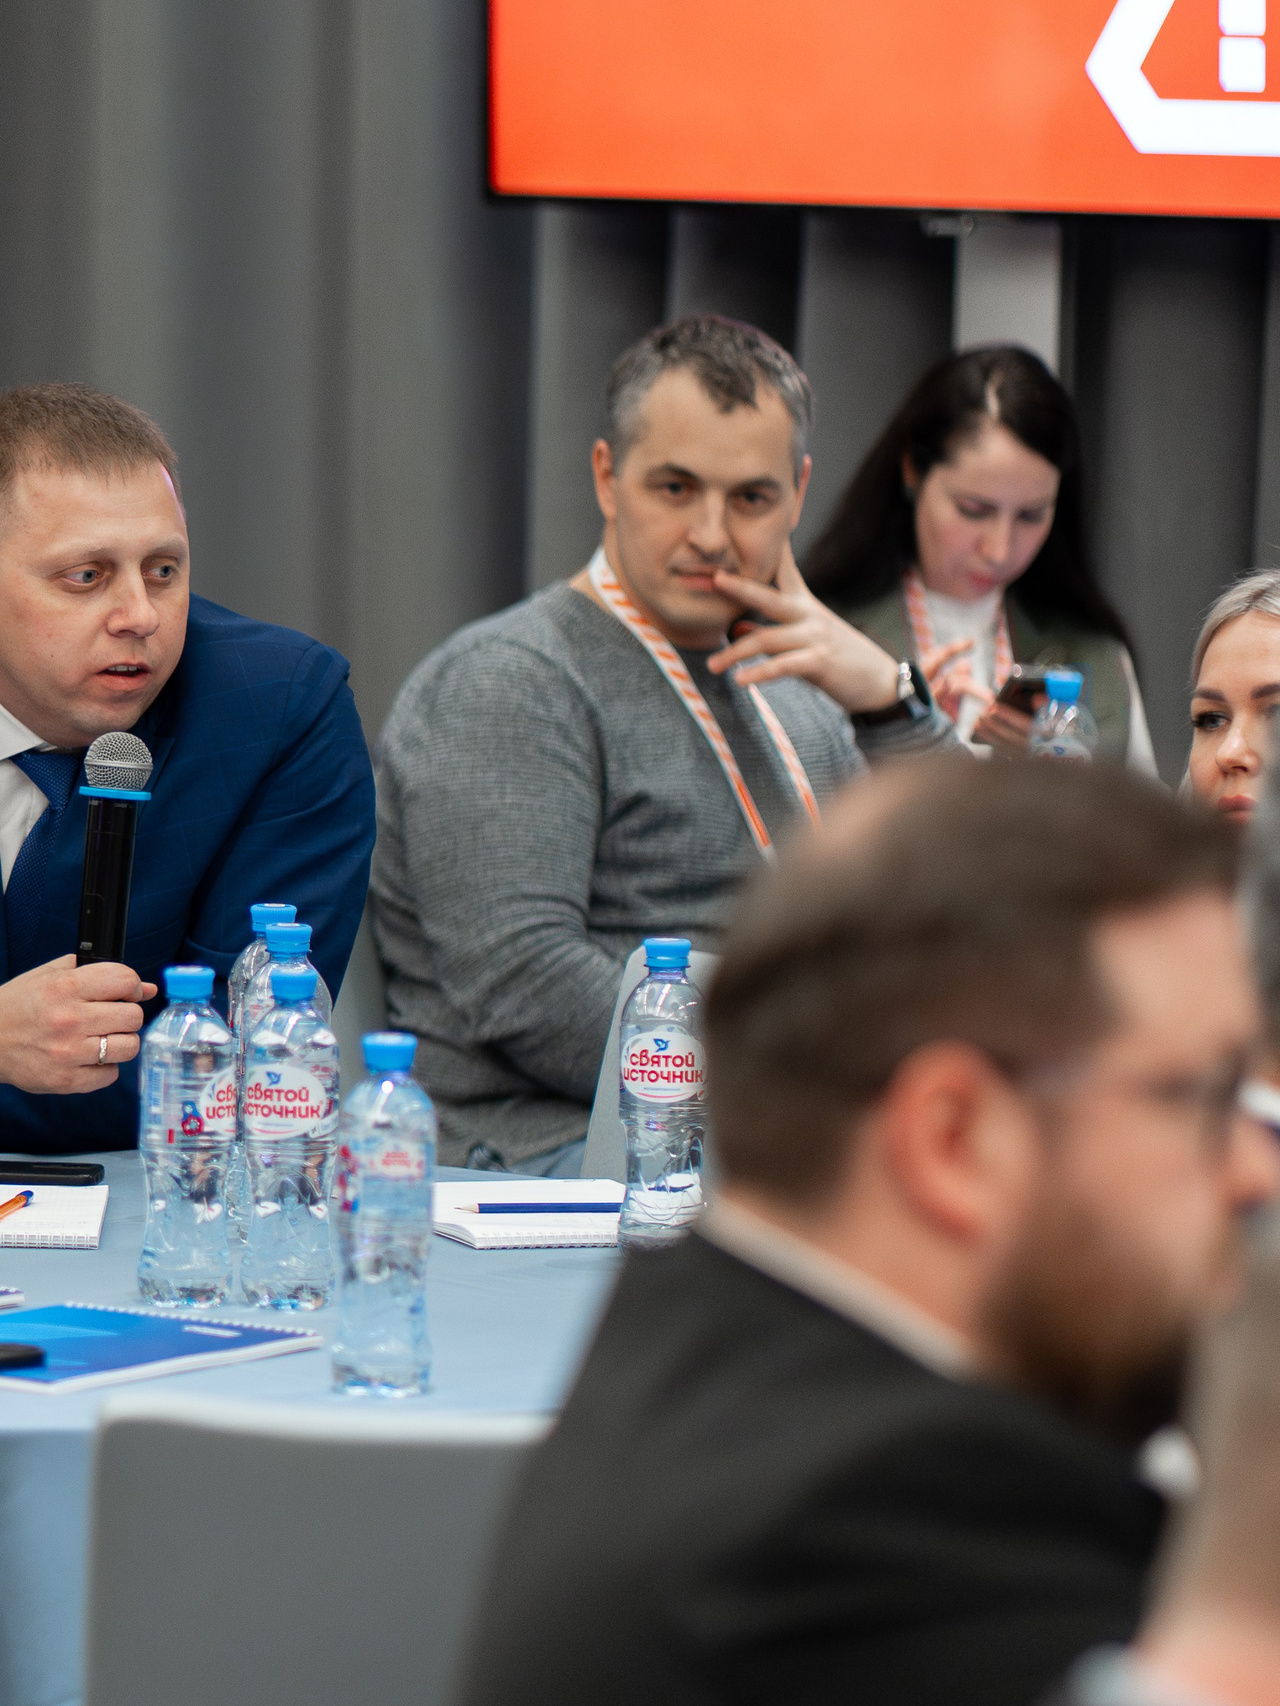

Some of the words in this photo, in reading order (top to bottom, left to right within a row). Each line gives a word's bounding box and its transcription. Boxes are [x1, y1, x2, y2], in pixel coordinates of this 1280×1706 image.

[629, 1049, 695, 1068] святой
[623, 1067, 703, 1083] источник
[247, 1082, 309, 1102] святой
